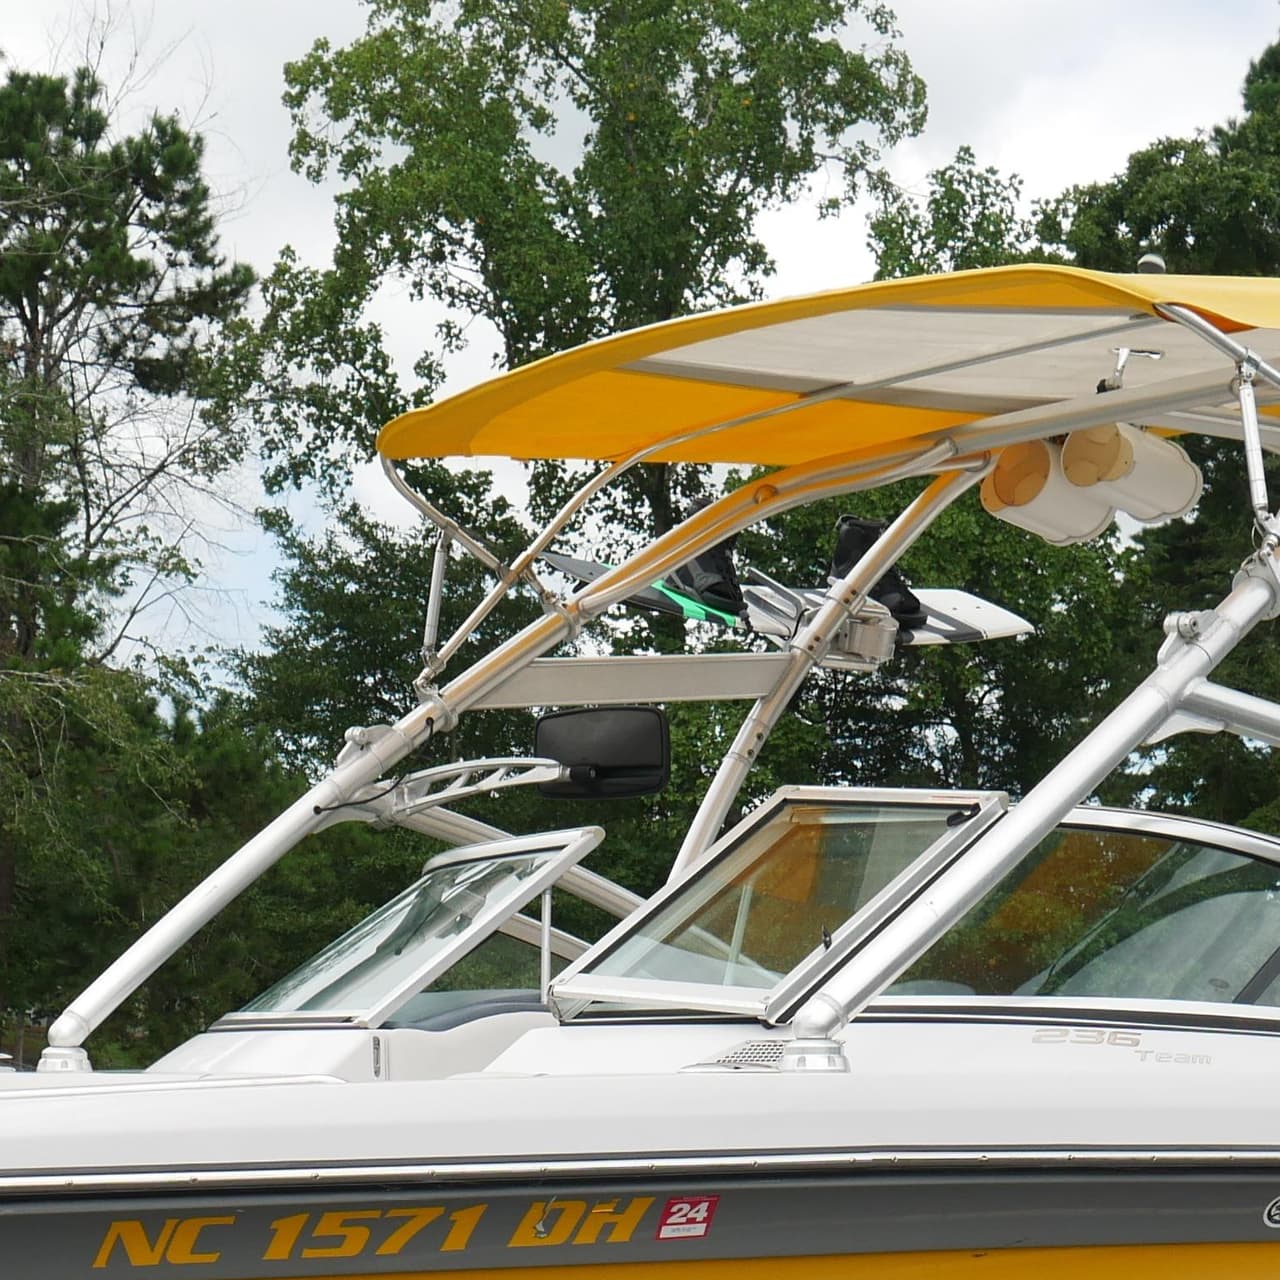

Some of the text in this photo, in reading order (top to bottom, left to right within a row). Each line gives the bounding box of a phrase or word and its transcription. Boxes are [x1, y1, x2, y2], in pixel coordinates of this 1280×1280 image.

[1031, 1027, 1142, 1048] 236
[1134, 1049, 1213, 1066] Team
[666, 1201, 710, 1224] 24
[91, 1196, 656, 1269] NC 1571 DH
